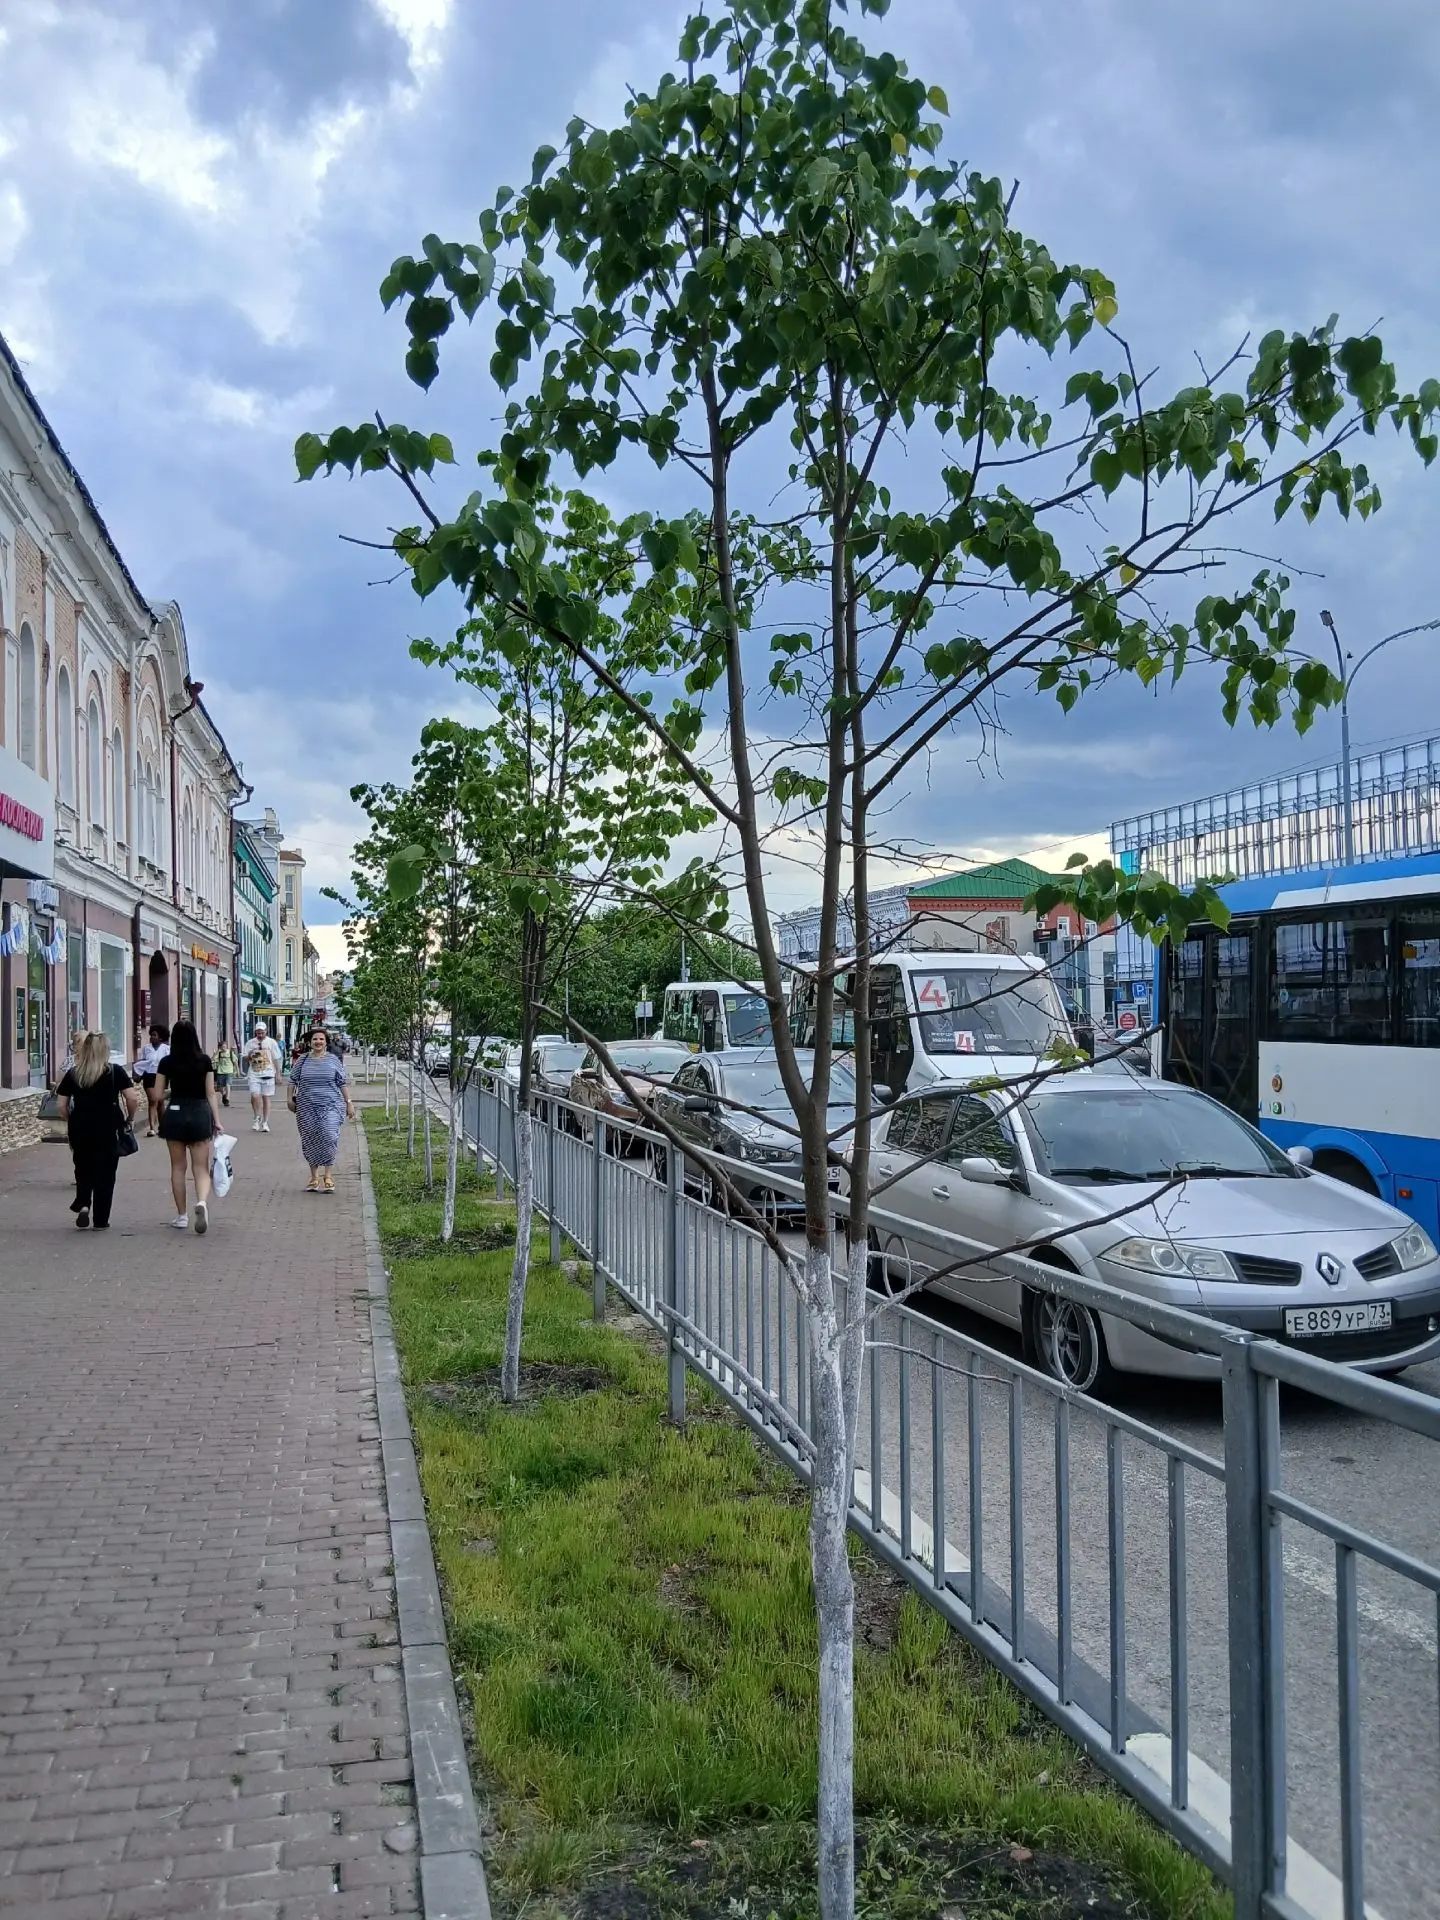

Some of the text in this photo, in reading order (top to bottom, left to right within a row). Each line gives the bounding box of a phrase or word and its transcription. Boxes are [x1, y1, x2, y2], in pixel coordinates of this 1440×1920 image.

[919, 979, 946, 1008] 4
[956, 1033, 972, 1051] 4
[1370, 1303, 1386, 1319] 73
